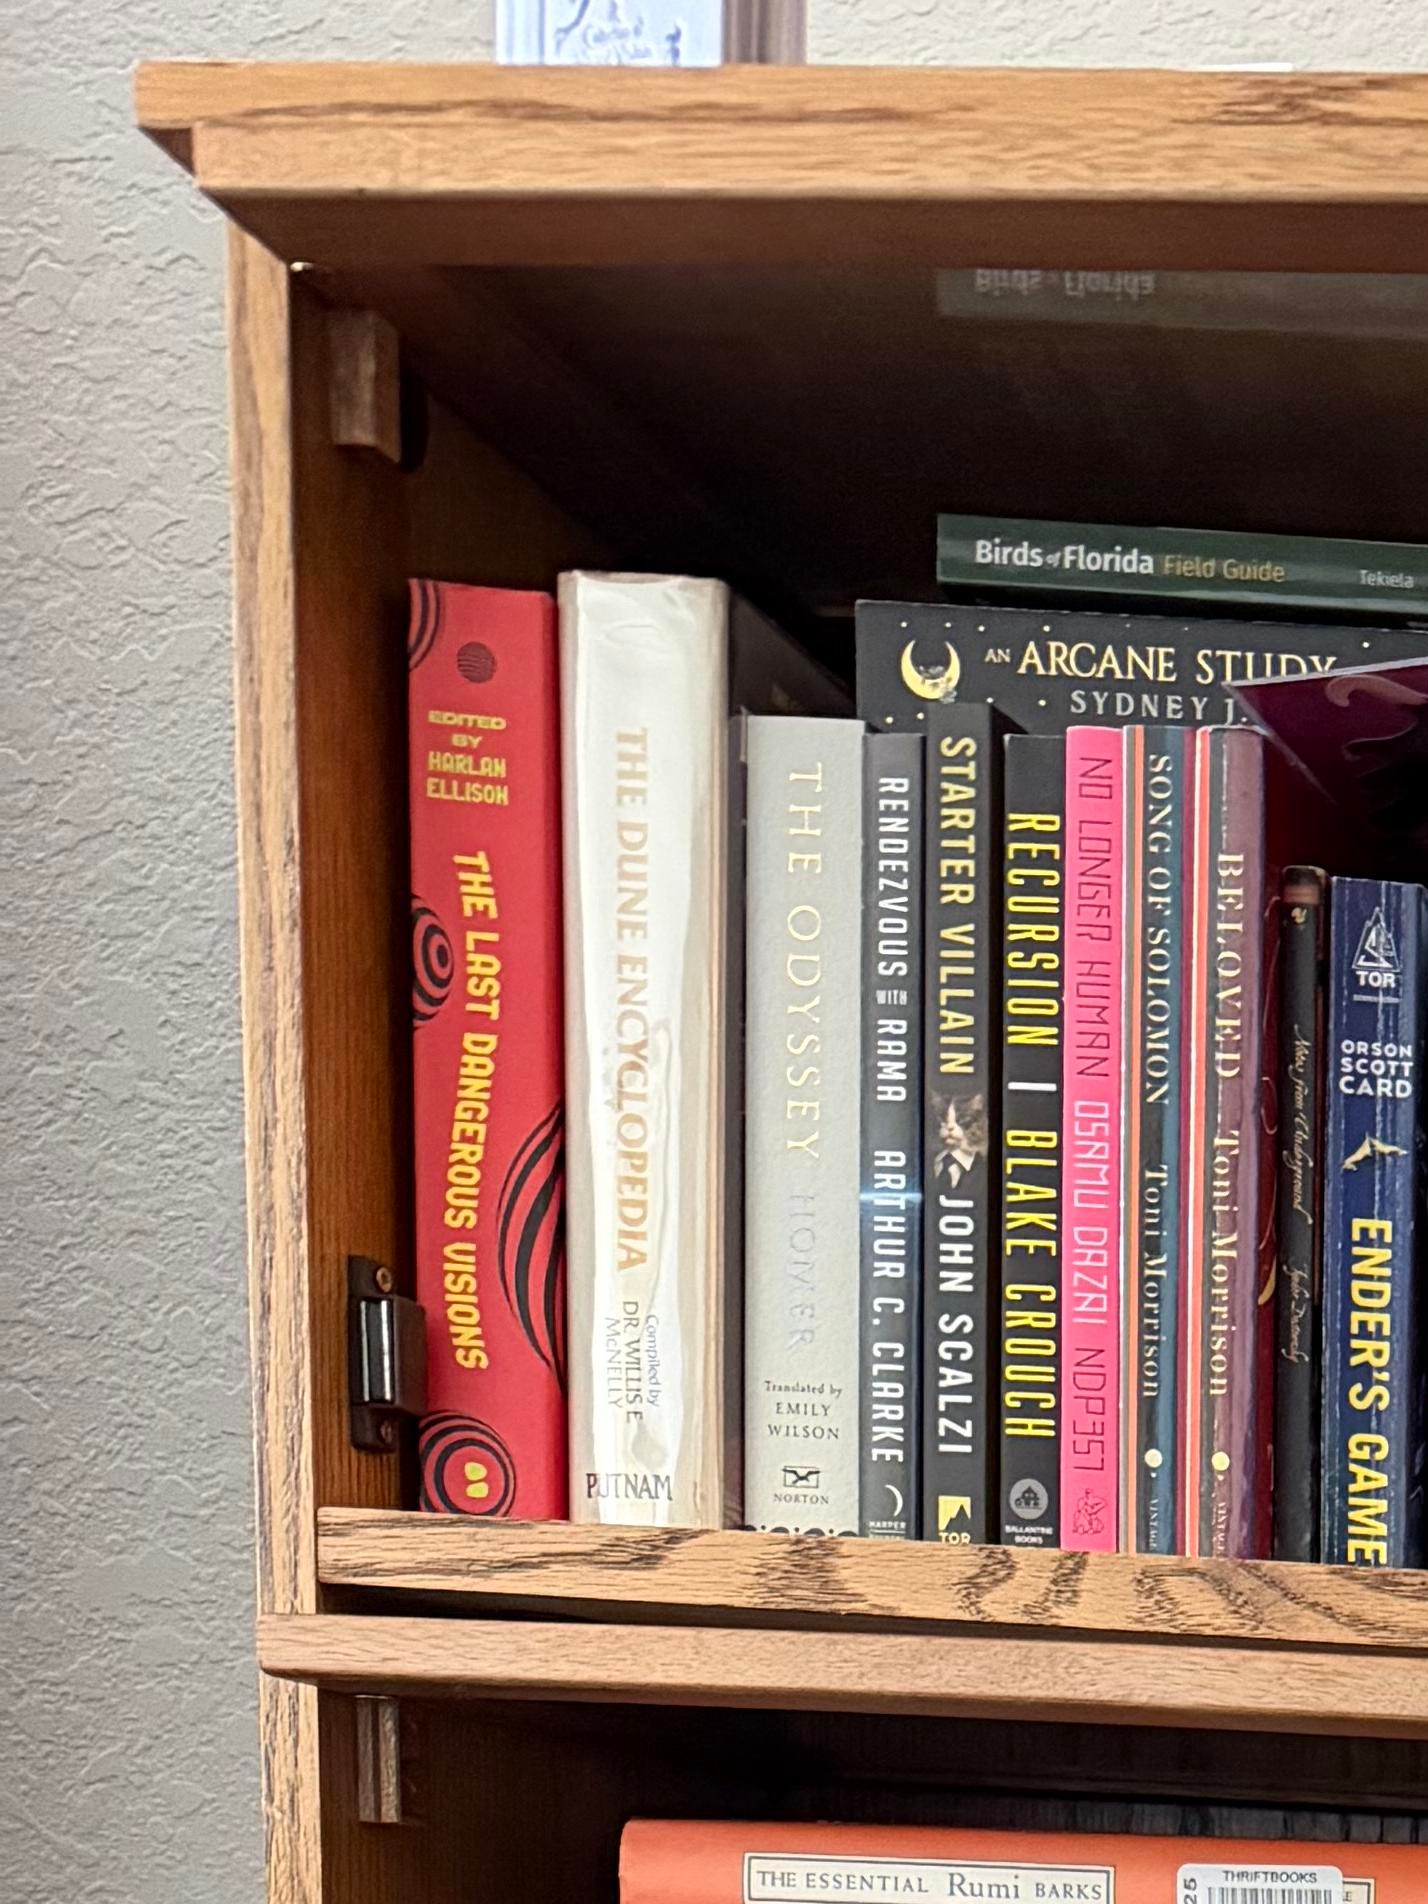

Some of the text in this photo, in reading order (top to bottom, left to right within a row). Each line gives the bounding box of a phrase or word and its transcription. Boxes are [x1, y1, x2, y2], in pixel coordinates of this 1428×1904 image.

[975, 539, 1043, 568] Birds
[1062, 545, 1155, 577] Florida
[1164, 555, 1217, 579] Field
[1222, 558, 1285, 582] Guide
[428, 711, 506, 730] EDITED
[453, 734, 482, 748] BY
[428, 753, 507, 777] HARLAN
[427, 779, 509, 805] ELLISON
[787, 764, 822, 1159] THE ODYSSEY
[444, 851, 503, 1371] THE LAST DANGEROUS VISIONS
[1004, 813, 1060, 1439] RECURSION BLAKE CROUCH
[1346, 1220, 1391, 1563] ENDER'S GAME
[758, 1869, 1102, 1901] THE ESSENTIAL Rumi BARKS
[1223, 1870, 1317, 1884] THRIFTBOOKS
